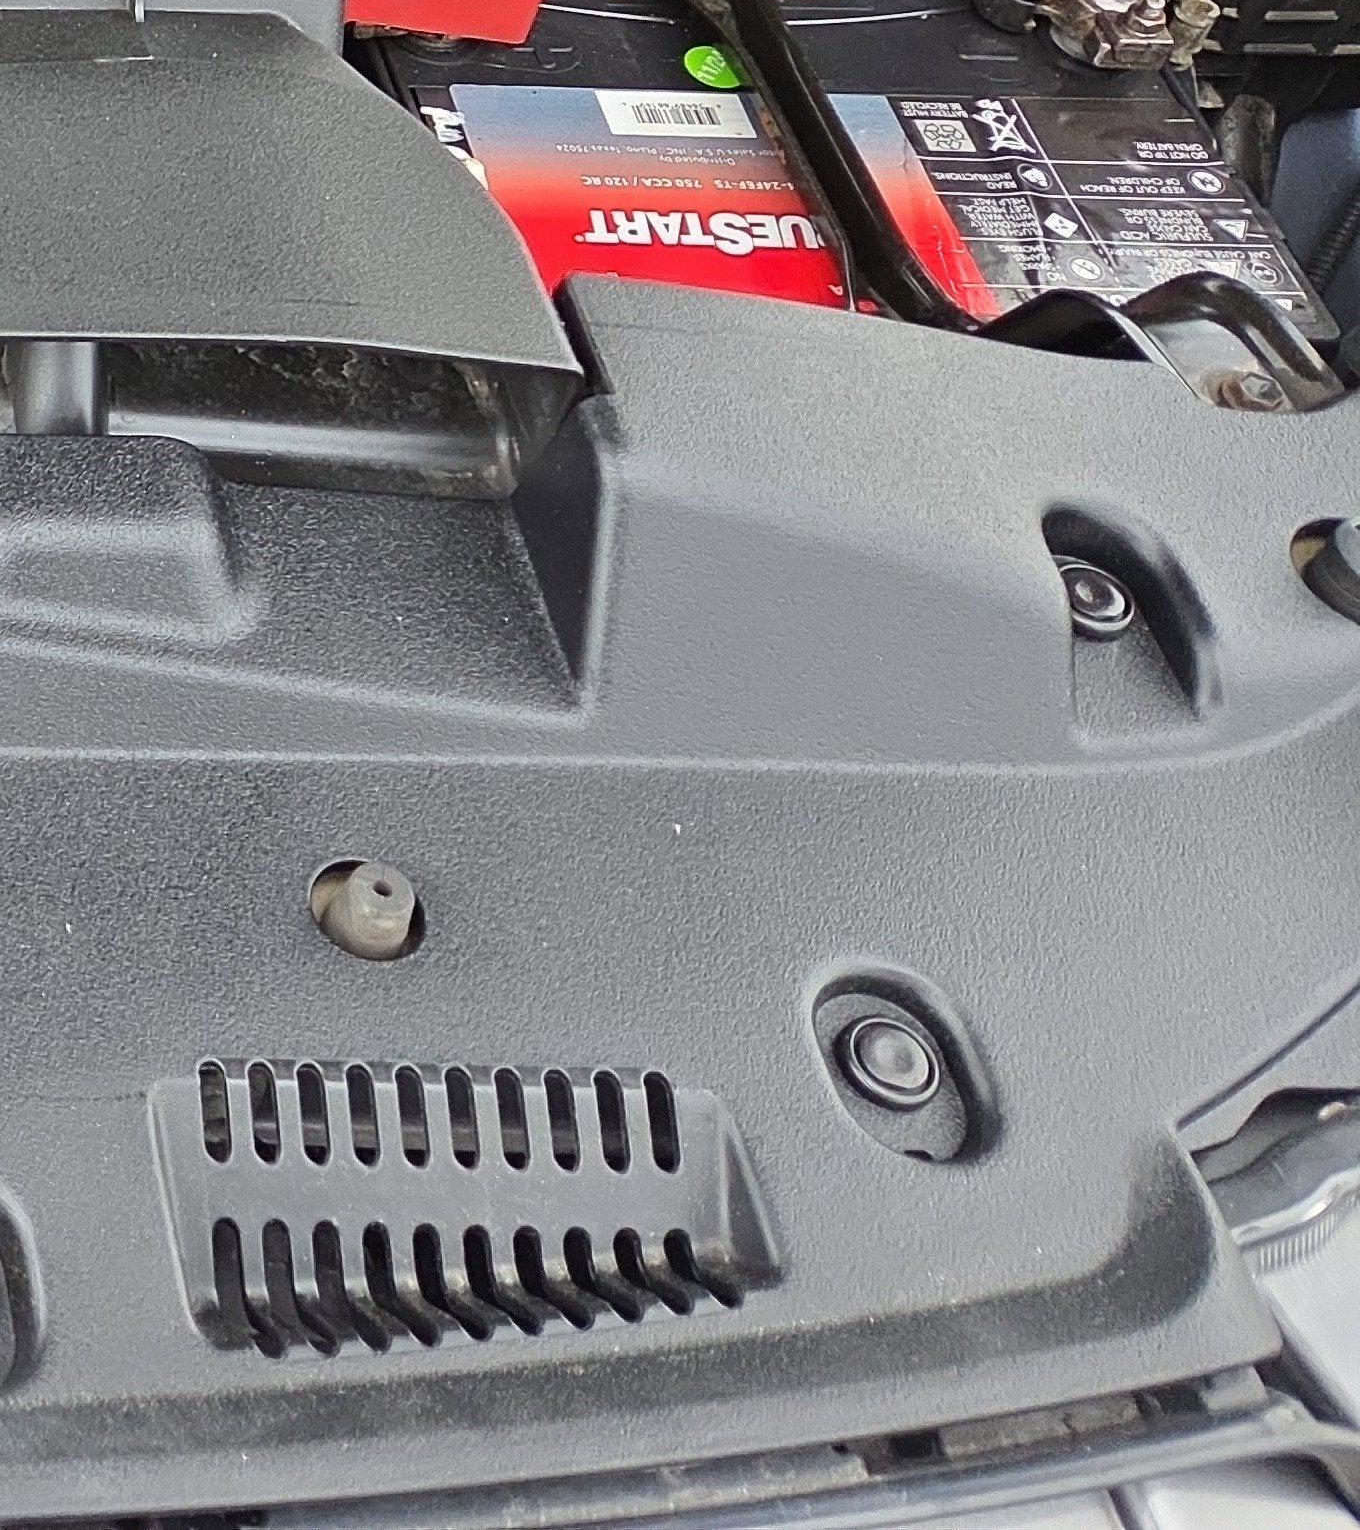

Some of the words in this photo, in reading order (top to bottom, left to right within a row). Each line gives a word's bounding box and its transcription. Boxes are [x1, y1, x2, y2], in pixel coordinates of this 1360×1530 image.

[947, 102, 961, 110] BE
[929, 109, 967, 118] BATTERY
[590, 145, 621, 153] Texas
[1174, 143, 1203, 151] OPEN
[1137, 150, 1152, 158] OR
[1170, 151, 1190, 159] NOT
[1191, 151, 1208, 159] DO
[675, 156, 736, 166] Distributed
[580, 176, 601, 185] RC
[604, 177, 629, 186] 120
[641, 178, 672, 187] CCA
[675, 178, 703, 188] 750
[986, 181, 1016, 189] READ
[1164, 177, 1180, 185] OF
[1080, 184, 1117, 192] REACH
[1117, 184, 1133, 193] OF
[1136, 185, 1158, 193] OUT
[1160, 185, 1185, 194] KEEP
[998, 197, 1025, 205] HELP
[1160, 209, 1198, 217] SEVERE
[1125, 215, 1142, 224] OR
[1143, 215, 1203, 225] BLINDNESS
[1147, 223, 1181, 233] CAUSE
[1184, 224, 1209, 233] CAN
[1119, 230, 1150, 240] ACID
[1152, 231, 1214, 242] SULFURIC
[1047, 271, 1067, 282] NO
